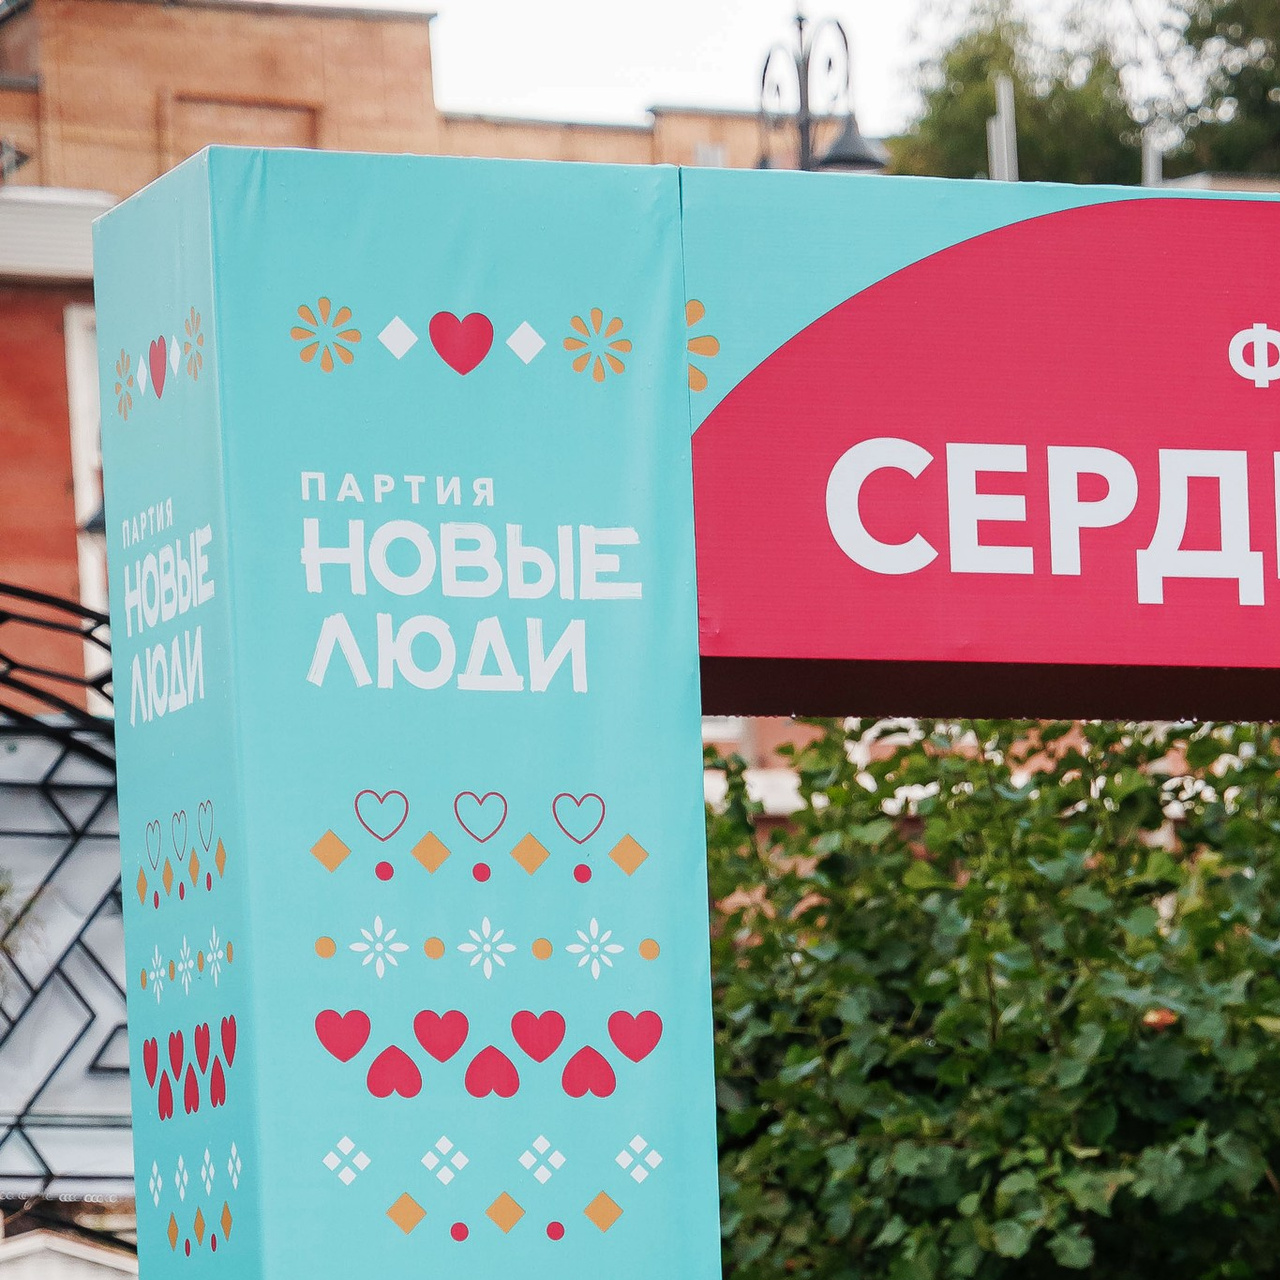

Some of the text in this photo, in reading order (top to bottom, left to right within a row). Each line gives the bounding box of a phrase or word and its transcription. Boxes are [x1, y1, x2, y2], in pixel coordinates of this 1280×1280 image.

[121, 497, 173, 550] ПАРТИЯ
[300, 471, 496, 507] ПАРТИЯ
[124, 523, 215, 638] НОВЫЕ
[300, 517, 645, 600] НОВЫЕ
[130, 624, 205, 728] ЛЮДИ
[306, 612, 589, 694] ЛЮДИ
